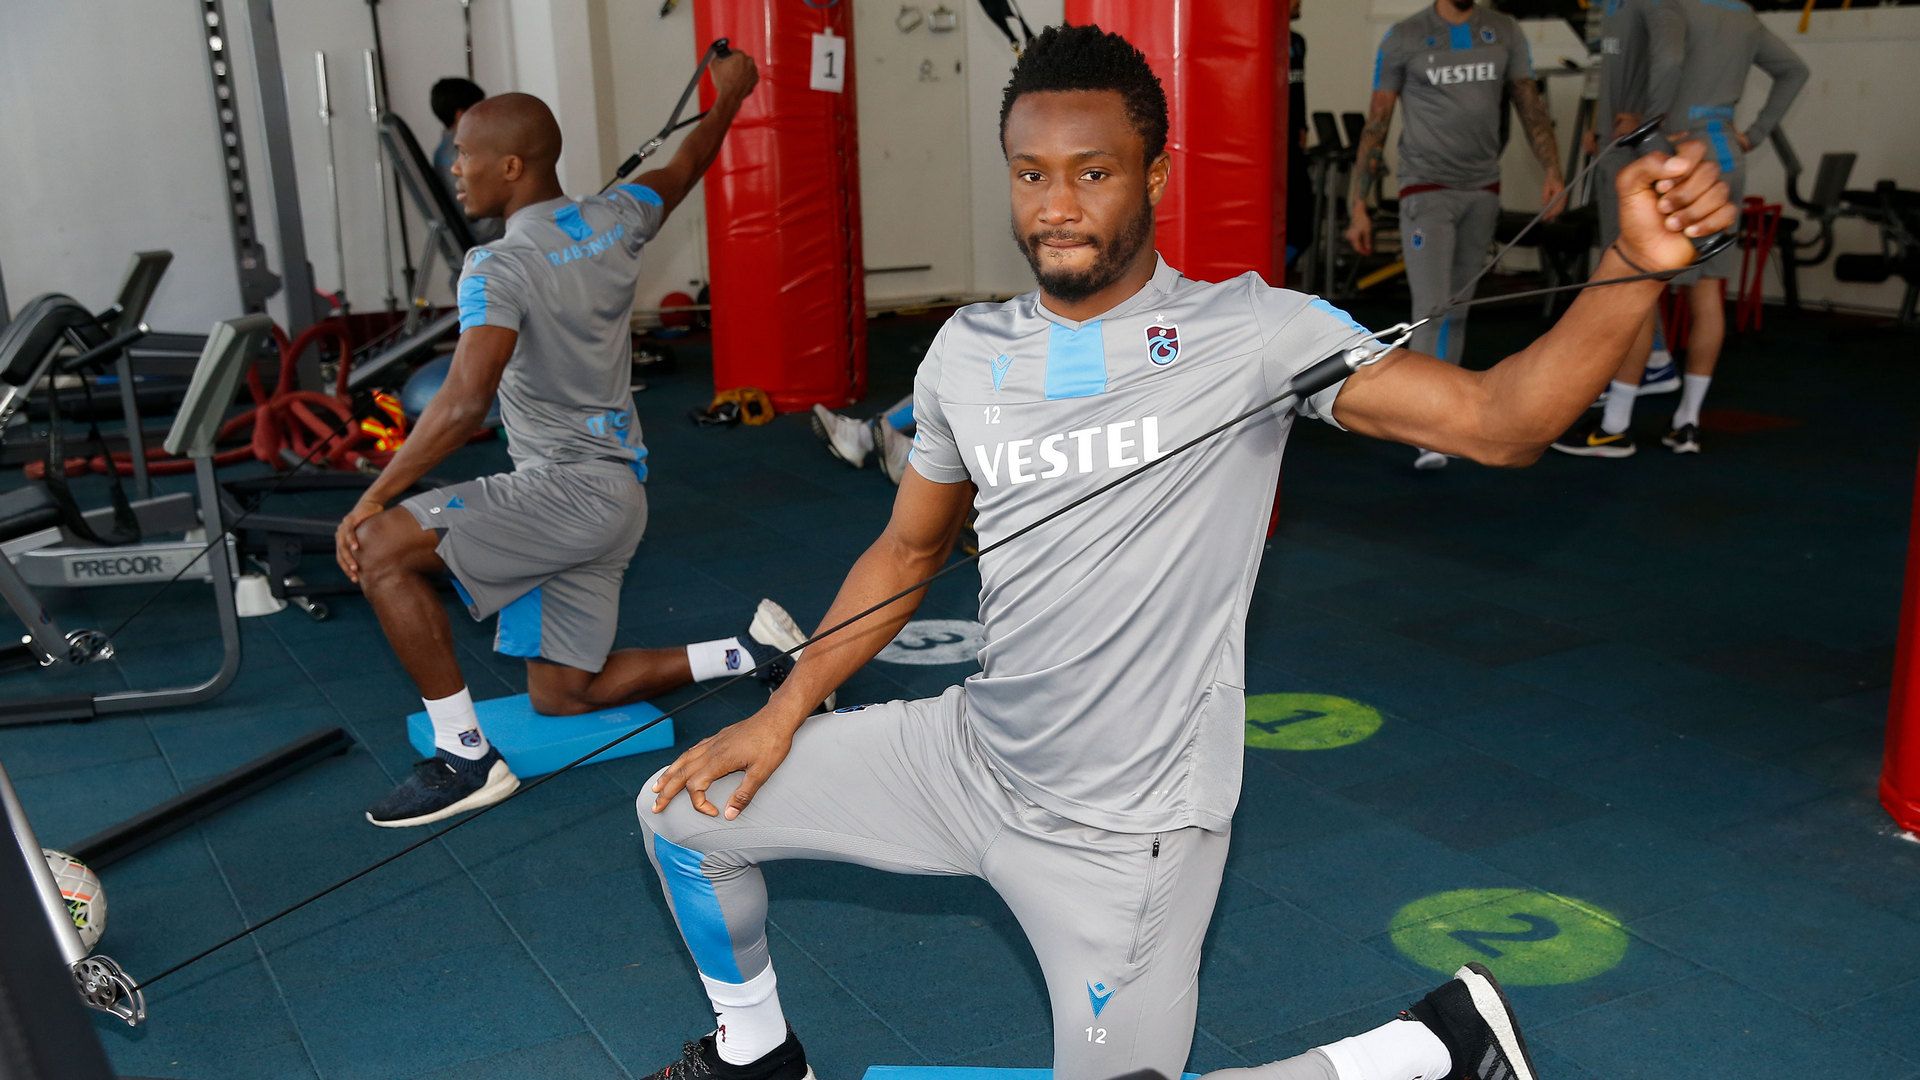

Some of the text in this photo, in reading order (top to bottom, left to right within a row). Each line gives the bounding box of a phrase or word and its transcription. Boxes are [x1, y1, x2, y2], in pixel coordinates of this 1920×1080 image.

[823, 51, 837, 79] 1
[1425, 62, 1497, 86] VESTEL
[983, 405, 1001, 425] 12
[974, 415, 1175, 487] VESTEL
[72, 556, 164, 578] PRECOR
[893, 632, 965, 651] 3
[1246, 708, 1329, 735] 1
[1447, 911, 1561, 960] 2
[1085, 1026, 1107, 1044] 12
